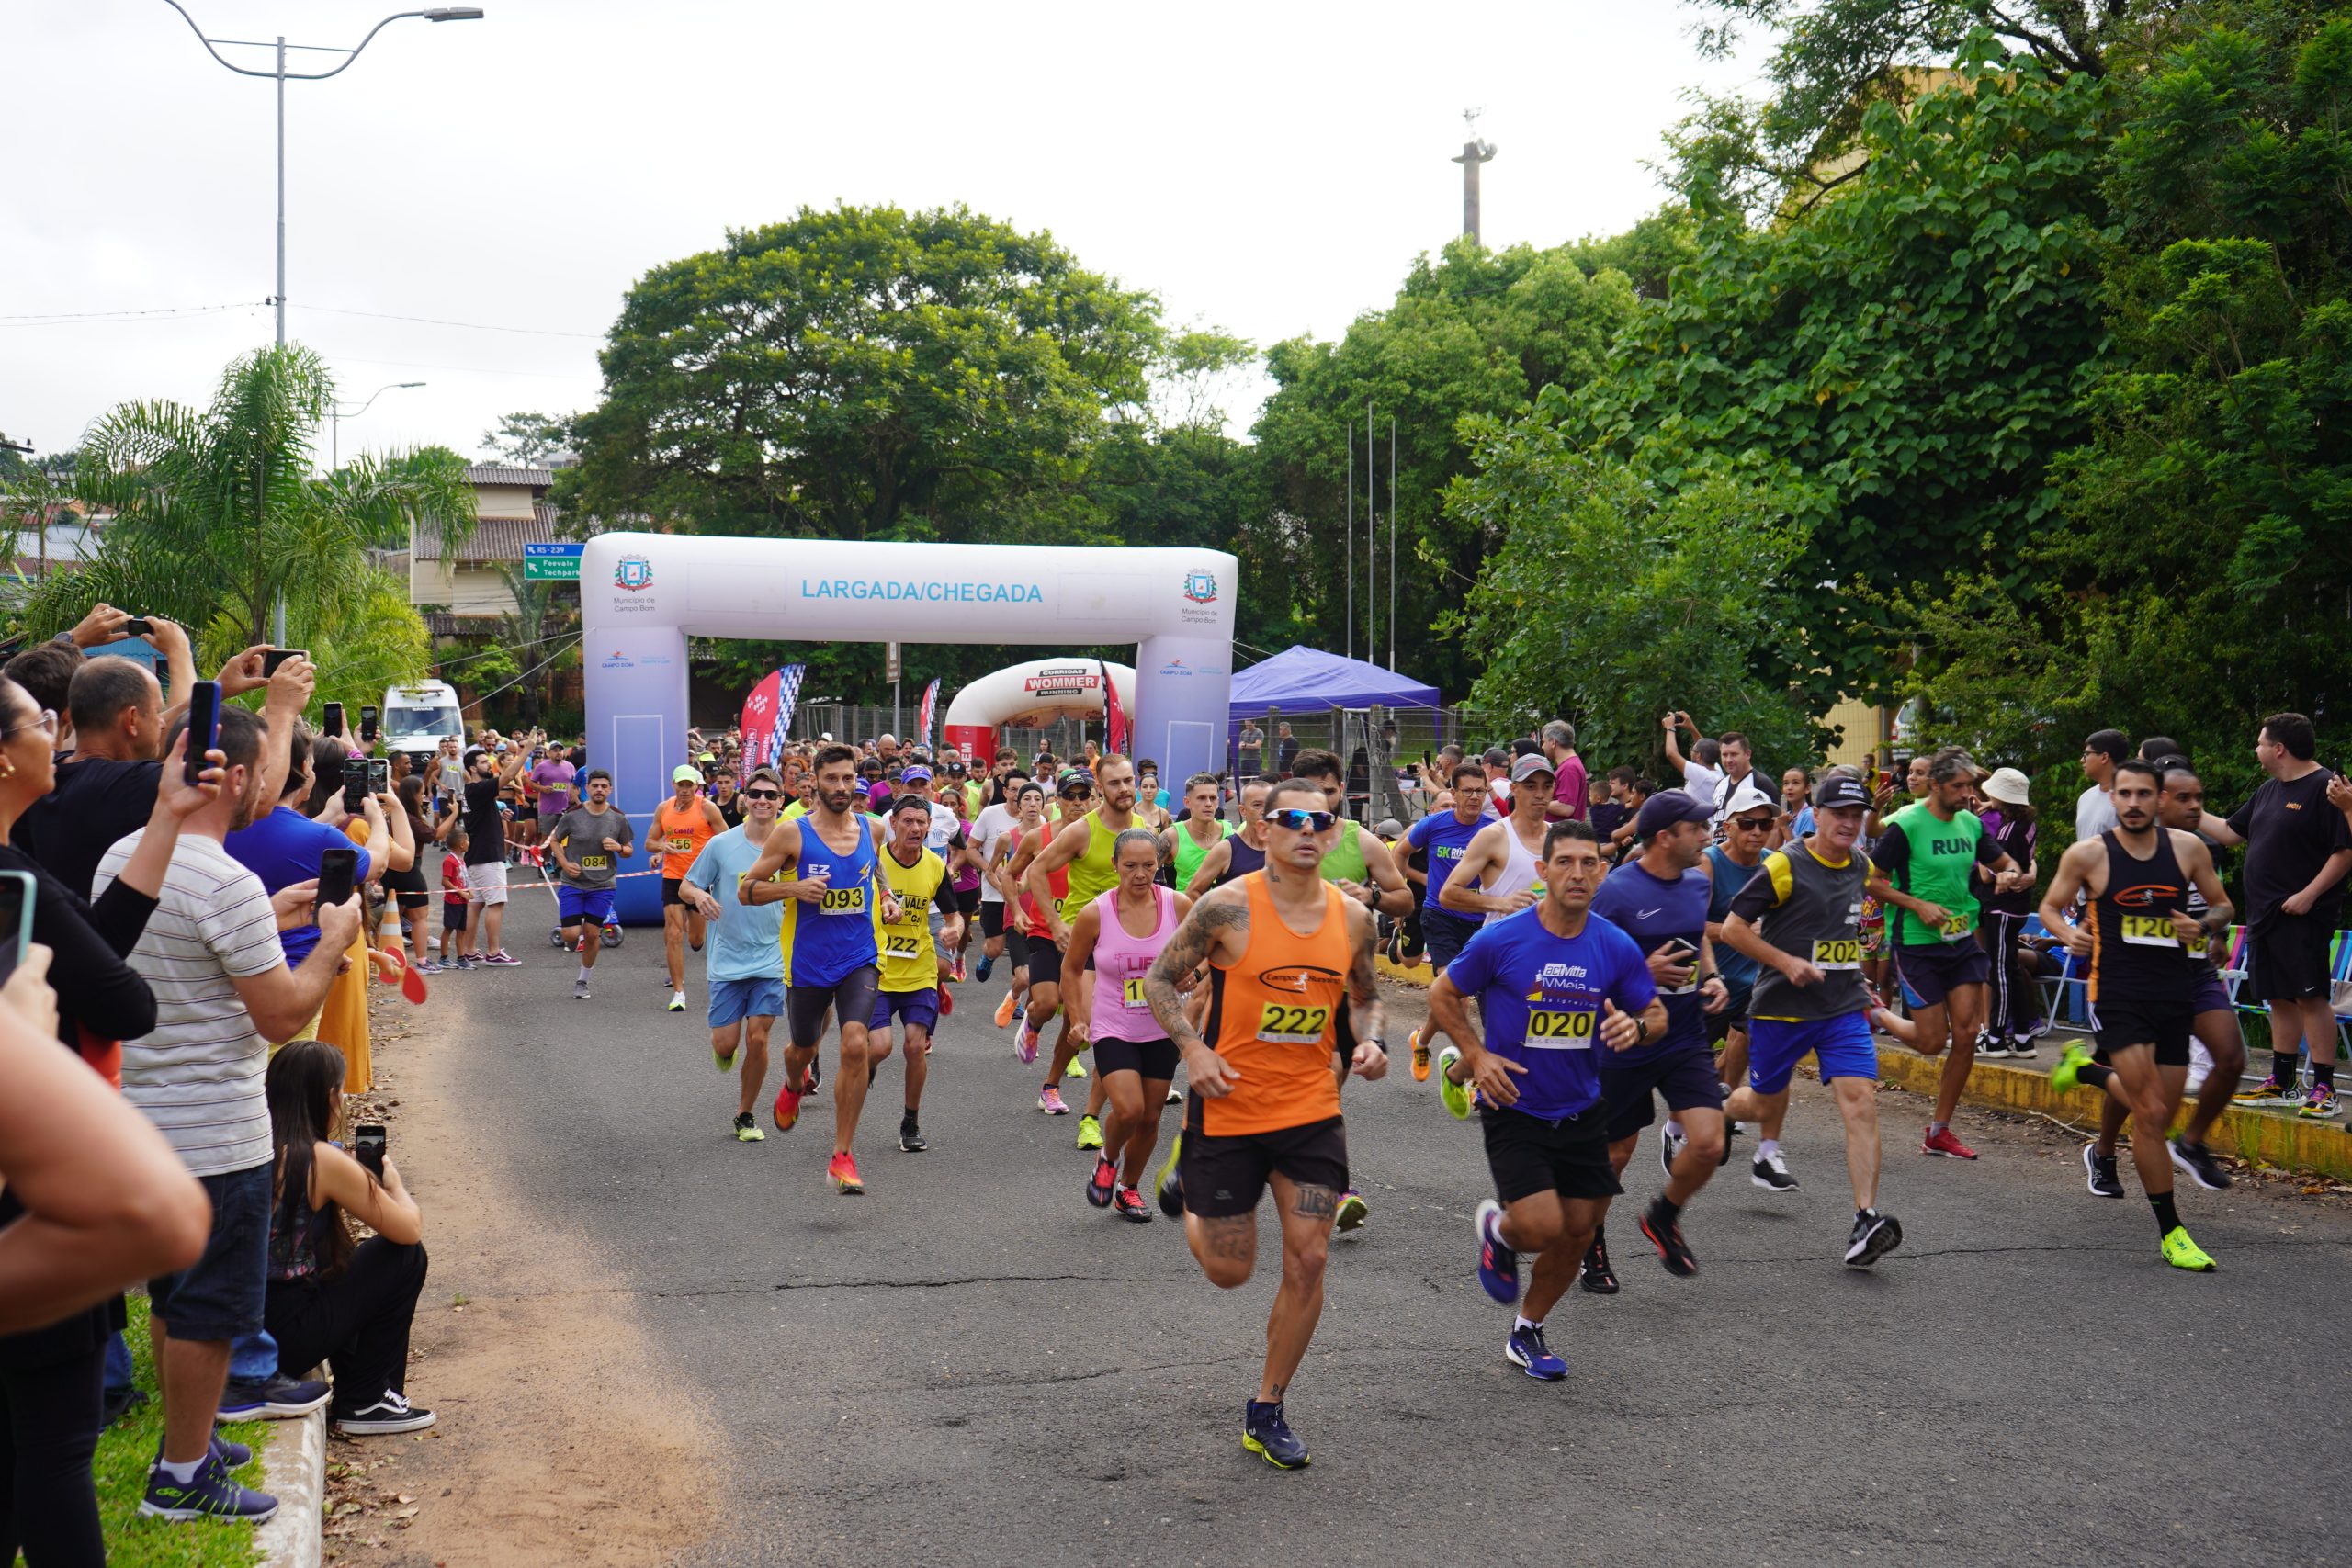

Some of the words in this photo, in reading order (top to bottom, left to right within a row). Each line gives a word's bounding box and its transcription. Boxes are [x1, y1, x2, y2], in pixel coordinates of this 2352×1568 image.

[802, 580, 1043, 603] LARGADA/CHEGADA
[1028, 677, 1095, 689] WOMMER
[1437, 846, 1451, 858] 5K
[1931, 837, 1973, 856] RUN
[583, 856, 605, 867] 084
[808, 863, 831, 875] EZ
[822, 888, 863, 908] 093
[905, 897, 927, 910] VALE
[2126, 917, 2174, 938] 120
[1815, 942, 1857, 963] 202
[1262, 1006, 1327, 1035] 222
[1531, 1011, 1590, 1037] 020
